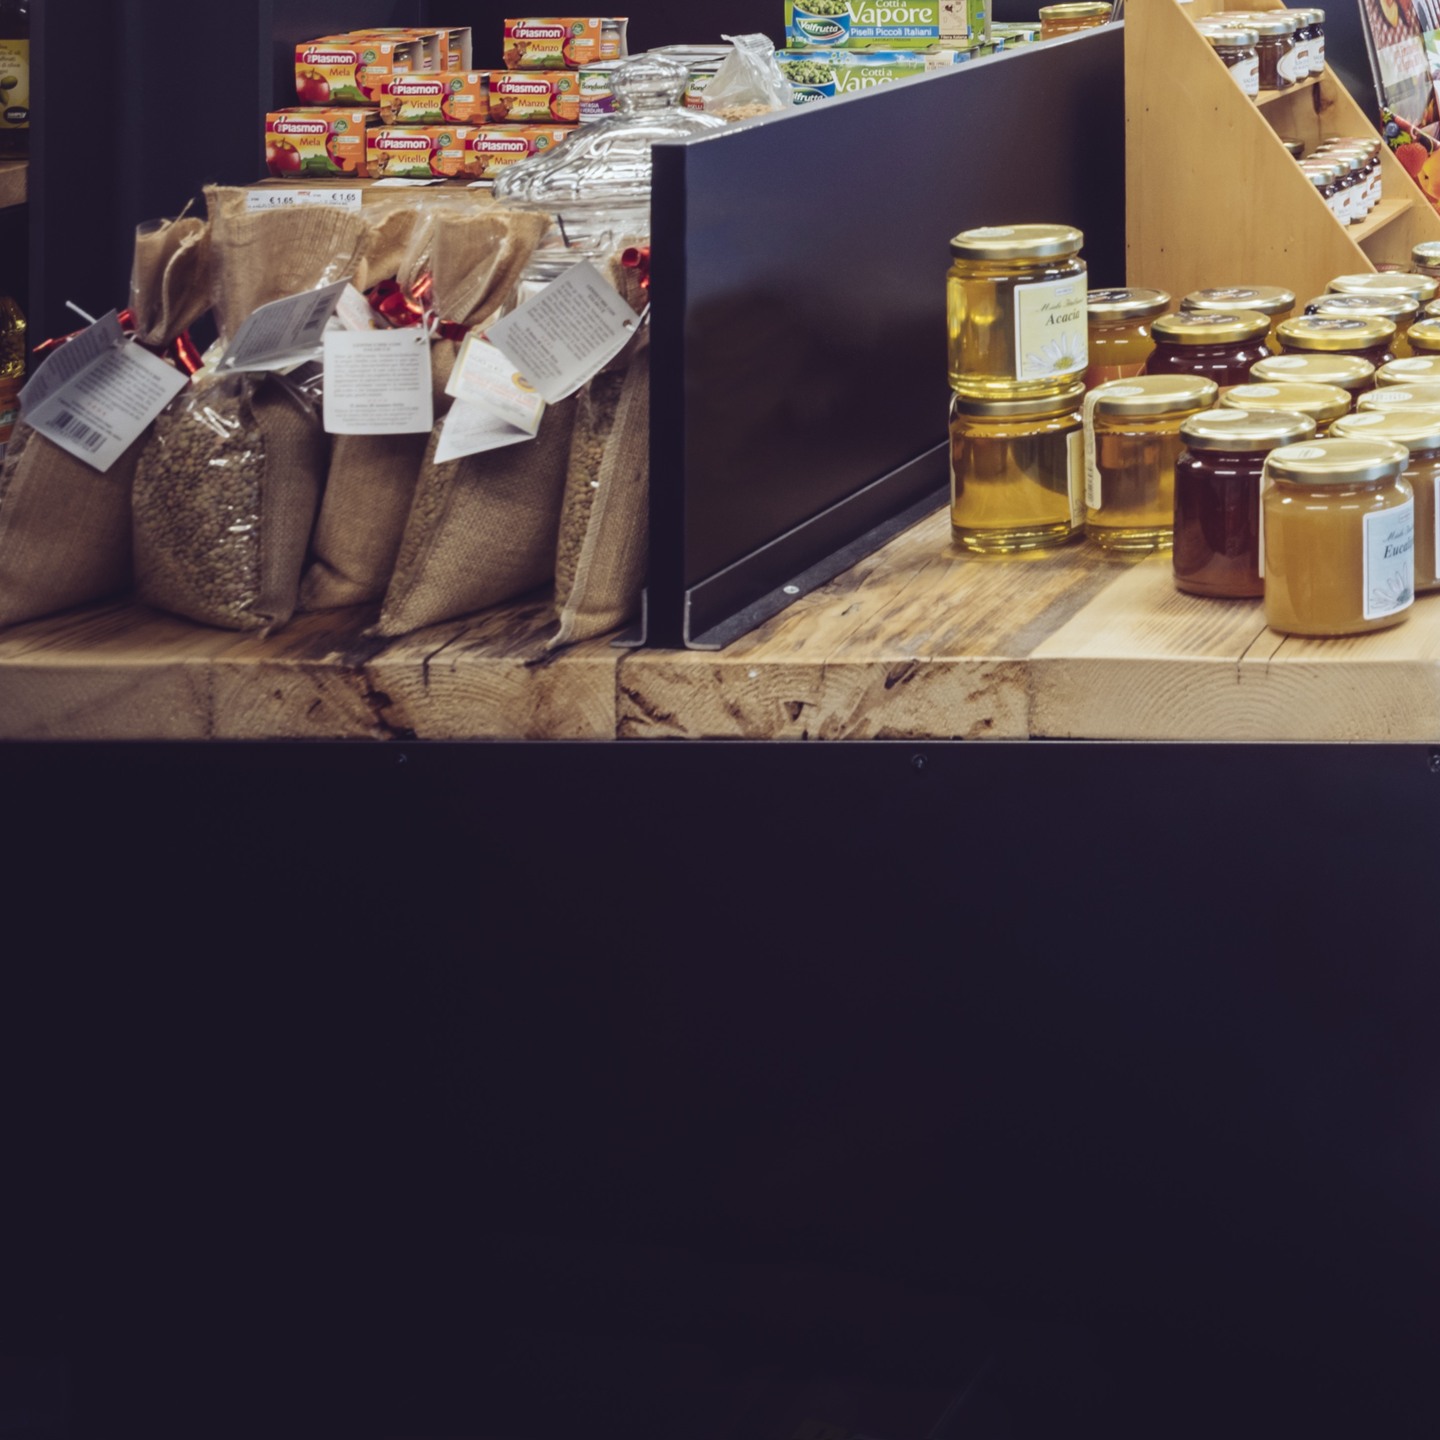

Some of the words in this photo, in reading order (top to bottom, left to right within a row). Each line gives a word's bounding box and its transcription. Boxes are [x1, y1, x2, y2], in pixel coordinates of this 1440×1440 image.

[876, 0, 899, 8] Cotti
[845, 2, 933, 27] Vapore
[800, 21, 839, 34] Valfrutta
[851, 27, 874, 36] Piselli
[875, 27, 902, 36] Piccoli
[904, 27, 932, 36] Italiani
[520, 28, 561, 39] Plasmon
[531, 42, 559, 53] Manzo
[311, 53, 353, 65] Plasmon
[329, 67, 350, 77] Mela
[861, 68, 885, 77] Cotti
[398, 84, 439, 95] Plasmon
[506, 83, 547, 94] Plasmon
[410, 99, 439, 109] Vitello
[518, 99, 546, 108] Manzo
[282, 123, 324, 134] Plasmon
[300, 137, 321, 146] Mela
[384, 138, 427, 150] Plasmon
[482, 140, 524, 152] Plasmon
[398, 154, 427, 164] Vitello
[1045, 309, 1080, 326] Acacia
